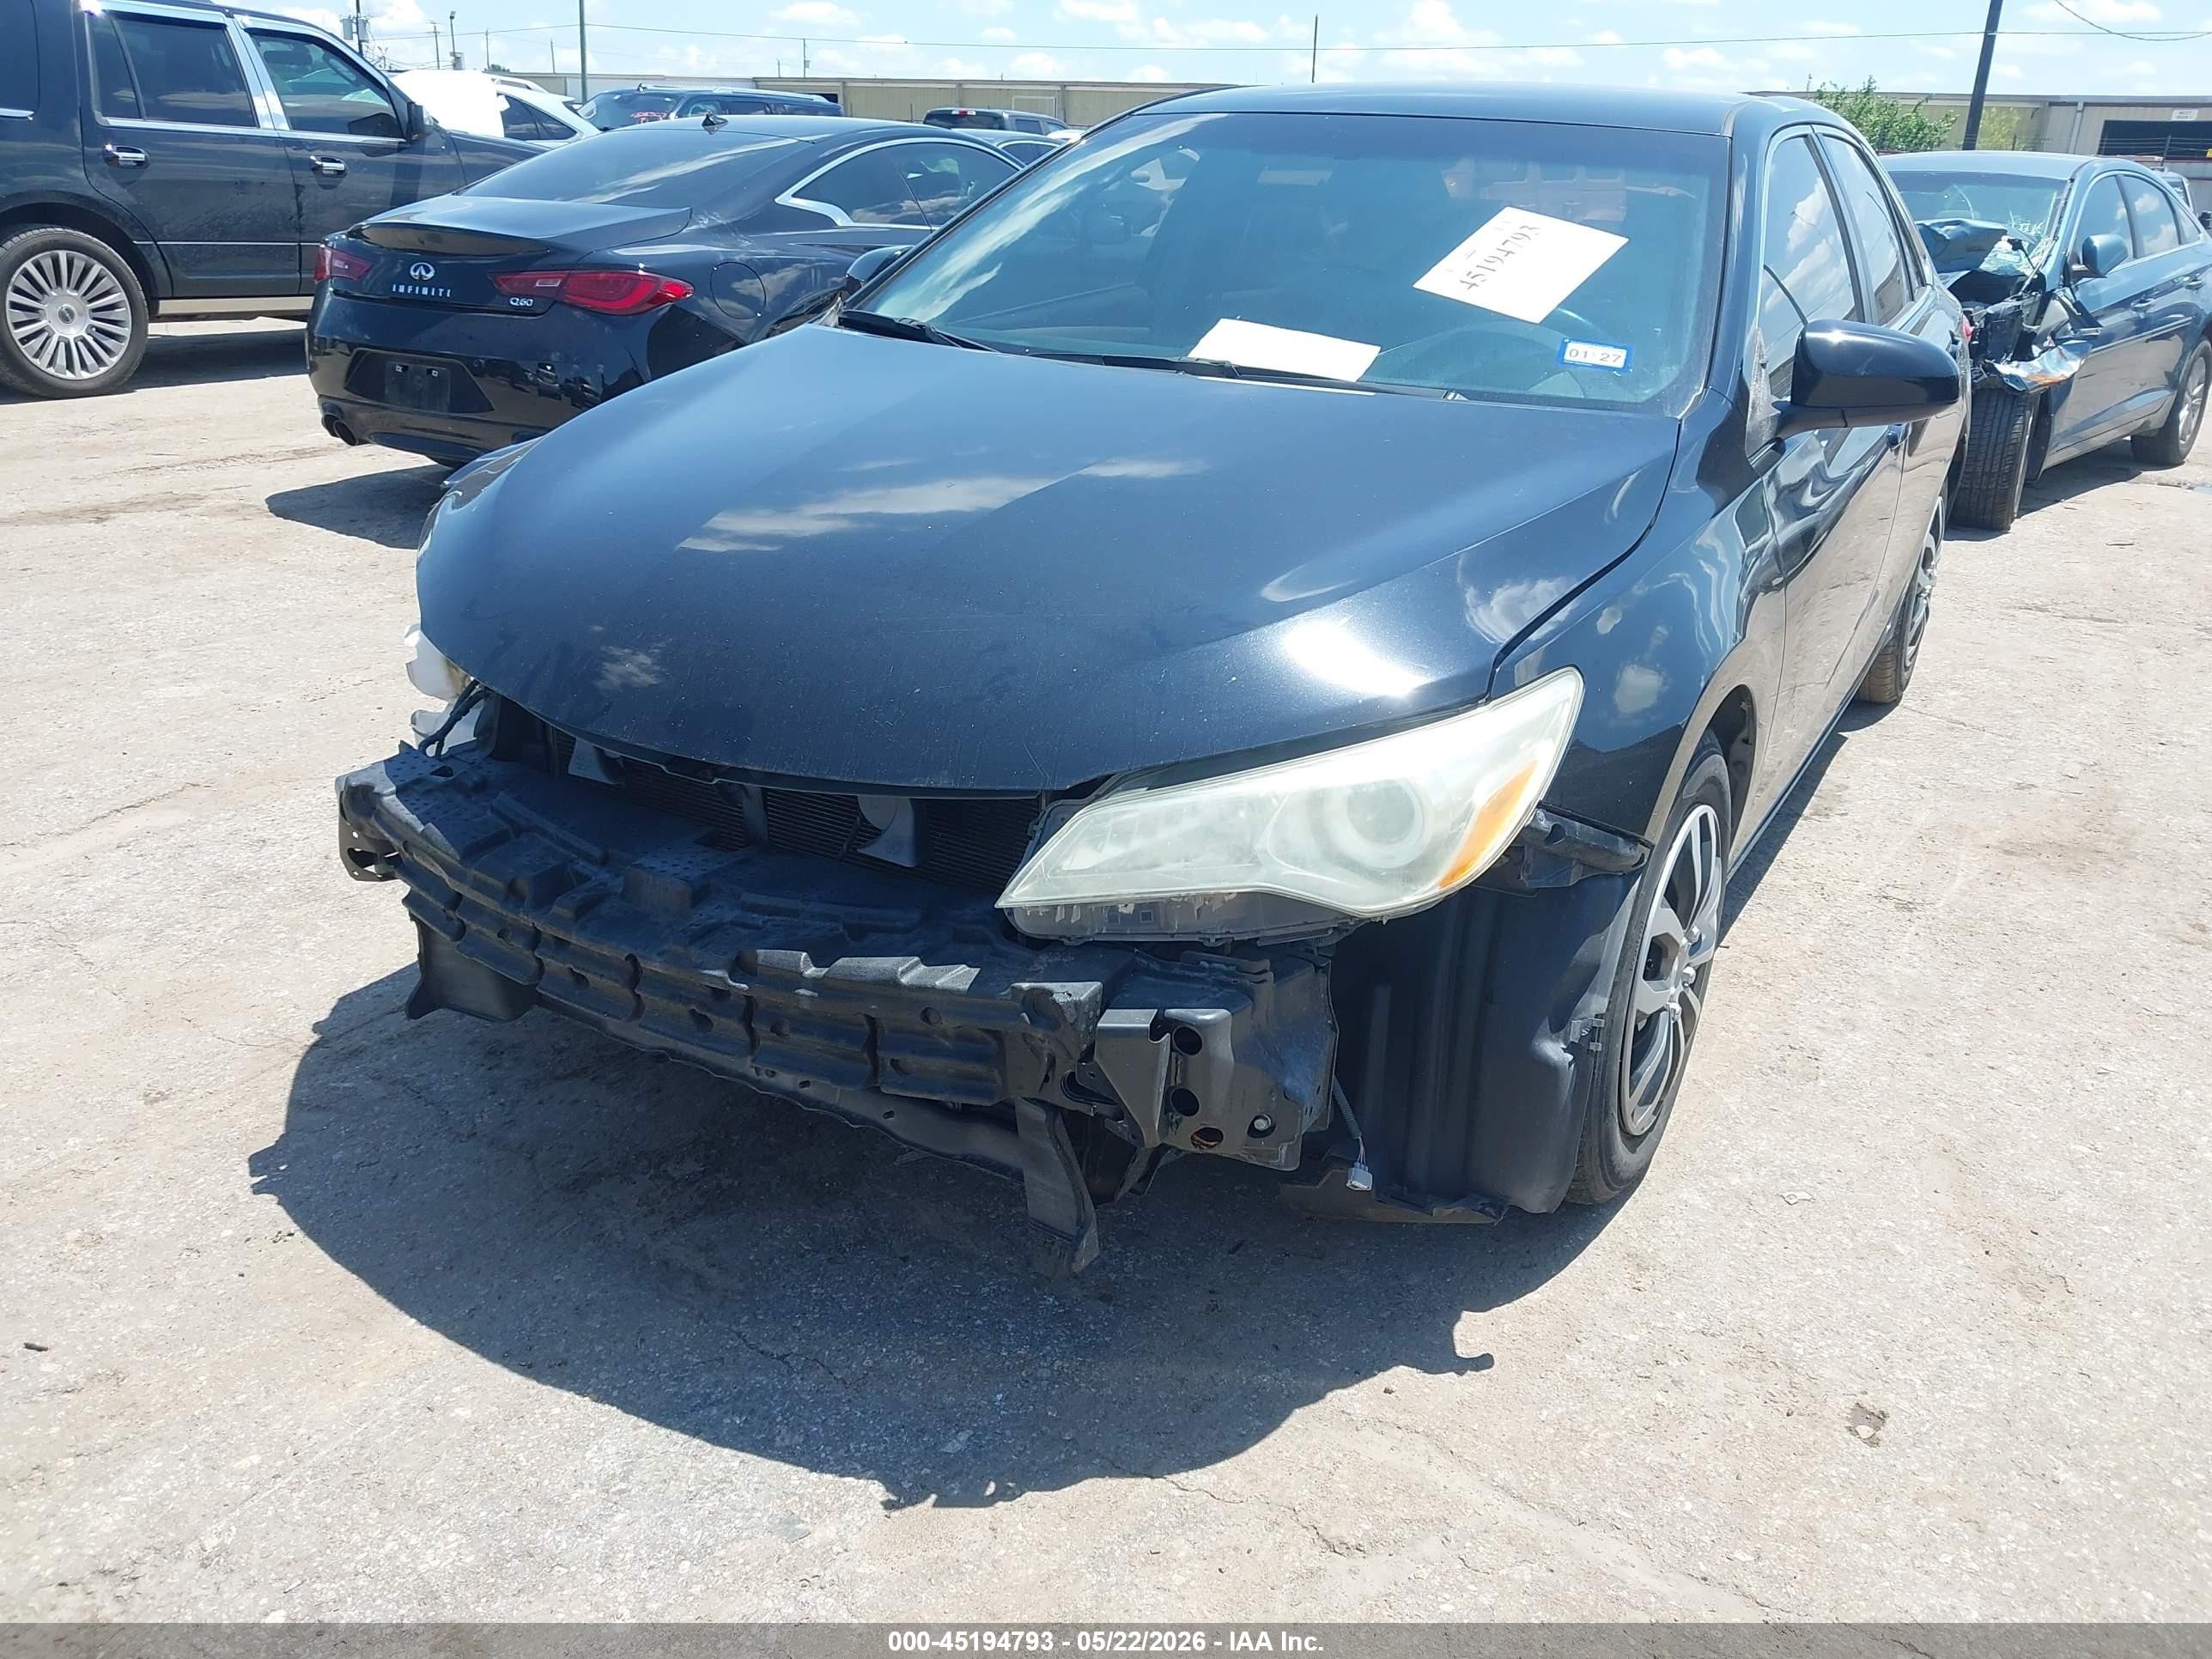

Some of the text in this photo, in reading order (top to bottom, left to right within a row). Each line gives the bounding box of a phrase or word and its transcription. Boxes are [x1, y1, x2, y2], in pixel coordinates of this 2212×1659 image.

[1459, 224, 1540, 290] 45194793
[392, 283, 452, 298] INFINITI
[509, 296, 535, 307] Q60
[1569, 348, 1622, 363] 01 27
